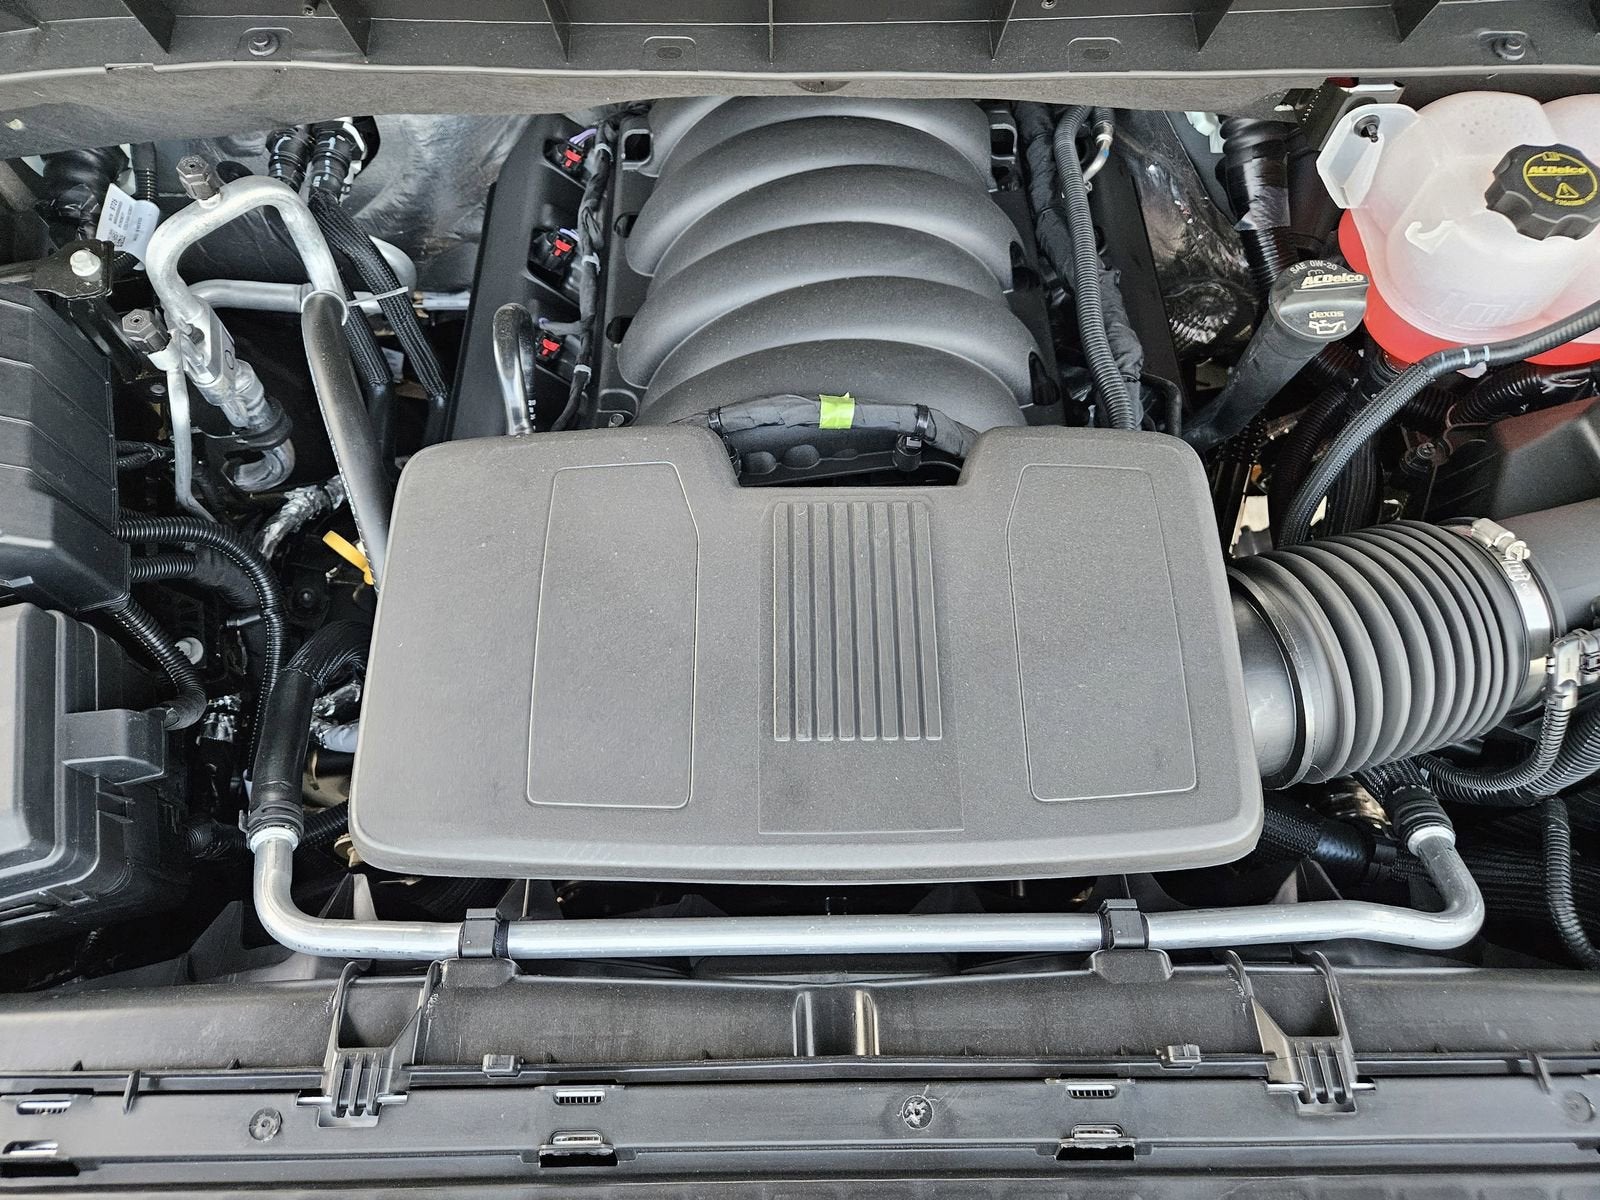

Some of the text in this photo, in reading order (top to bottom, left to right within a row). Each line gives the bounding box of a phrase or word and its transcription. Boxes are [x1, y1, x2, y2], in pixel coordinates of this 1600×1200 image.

[1527, 166, 1588, 177] ACDelco
[1290, 260, 1337, 274] SAE 0W-20
[1301, 273, 1365, 289] ACDelco
[1309, 311, 1345, 319] dexos
